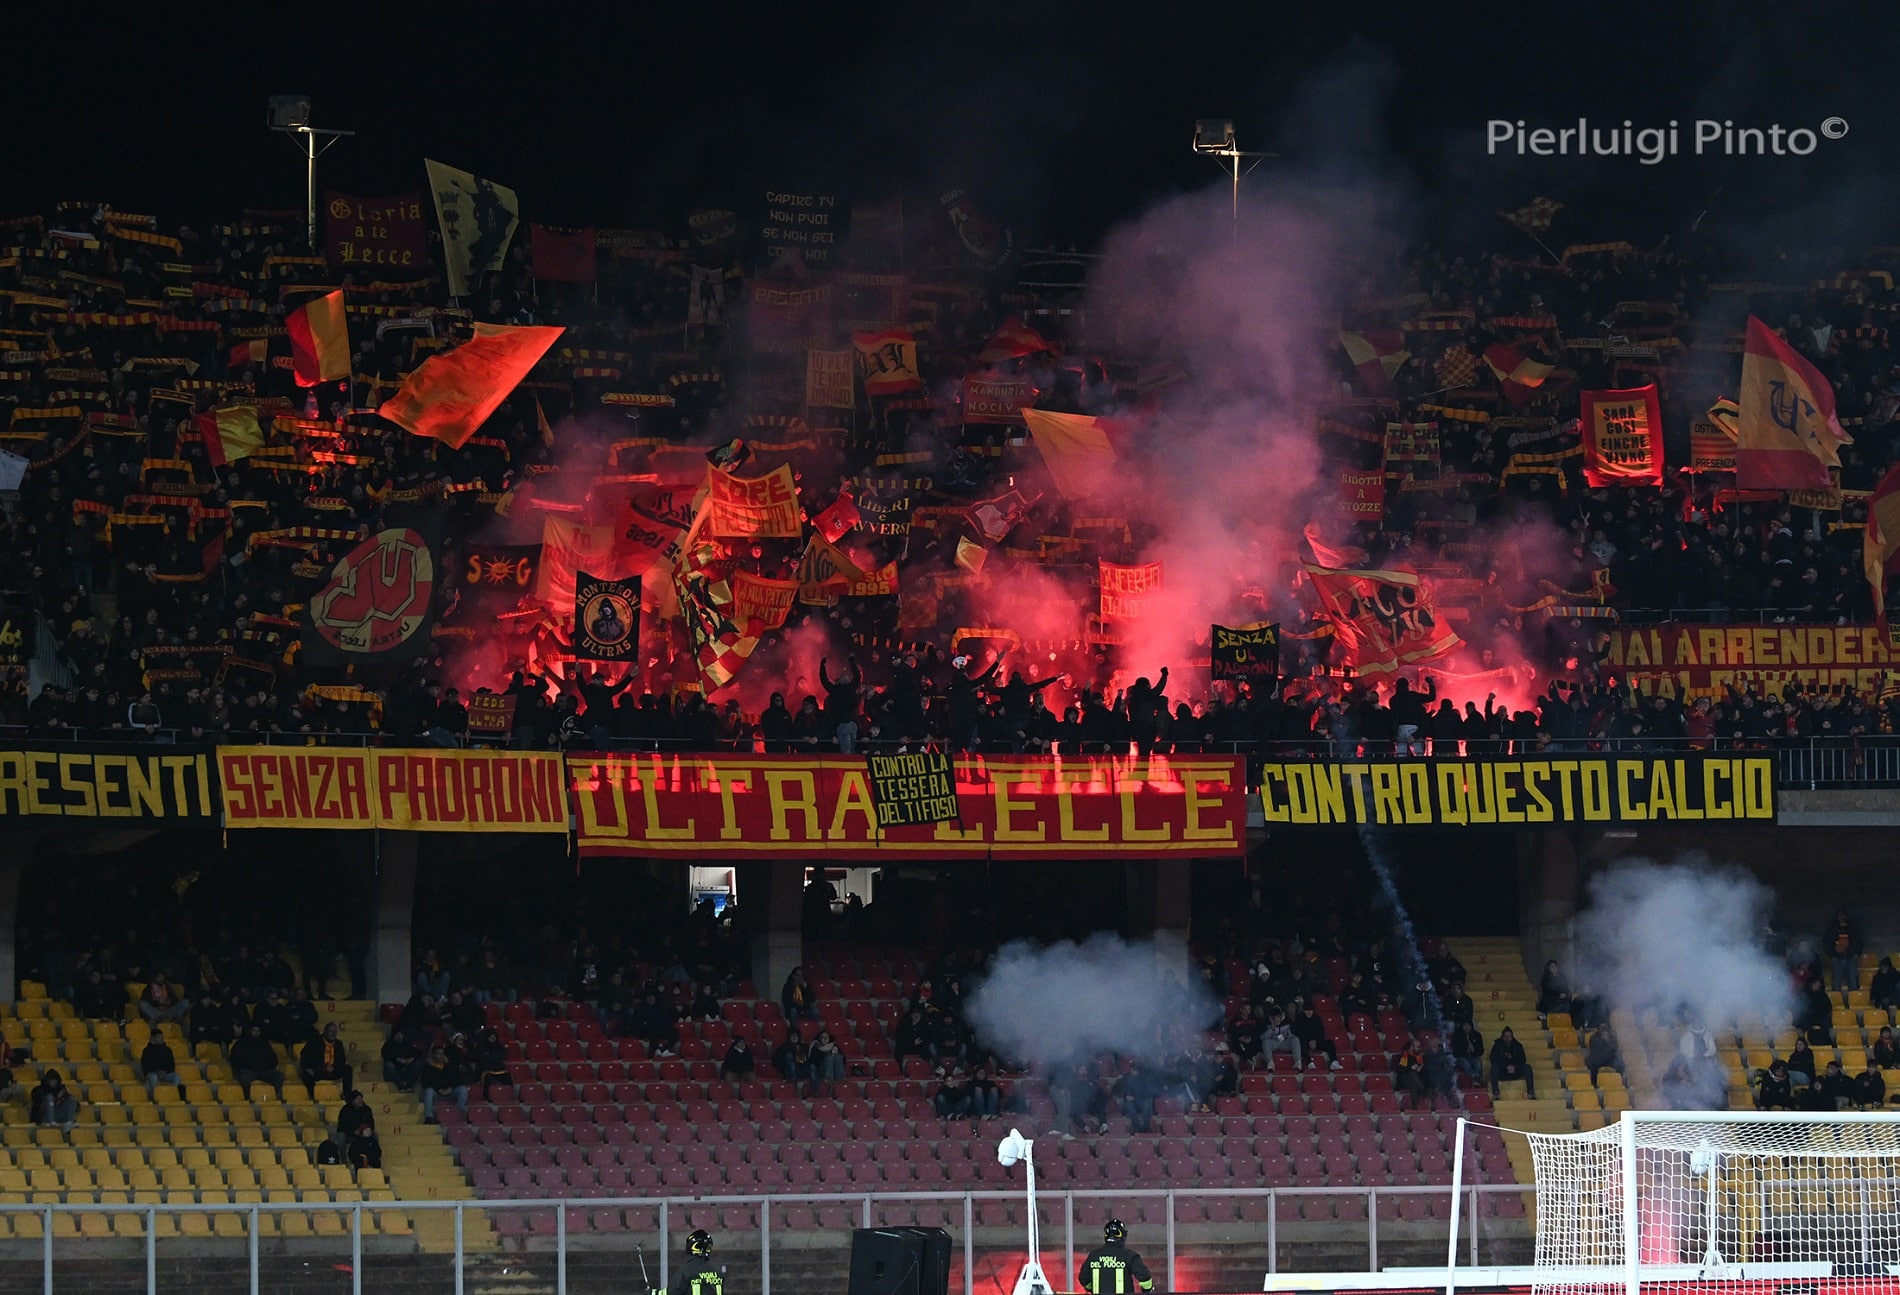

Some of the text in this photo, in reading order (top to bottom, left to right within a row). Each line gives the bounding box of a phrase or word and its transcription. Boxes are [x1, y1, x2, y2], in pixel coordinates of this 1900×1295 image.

[766, 191, 813, 207] CAPIRE
[330, 198, 422, 222] Gloria
[770, 210, 794, 224] NON
[762, 227, 834, 245] SE NON SEI
[337, 241, 413, 265] Lecce
[804, 249, 828, 261] NOI
[812, 353, 824, 369] IO
[969, 386, 1026, 397] MANDURIA
[1602, 405, 1636, 420] SARÀ
[1695, 457, 1737, 469] PRESENZA
[1341, 473, 1383, 486] RIDOTTI
[1357, 488, 1365, 499] A
[857, 495, 910, 514] LIBERI
[1340, 501, 1382, 513] STOZZE
[1100, 565, 1161, 593] INFERNO
[576, 581, 641, 609] MONTERONI
[848, 580, 891, 597] 1995
[581, 636, 632, 657] ULTRAS
[1217, 629, 1277, 649] SENZA
[1601, 629, 1664, 667] MAI
[1675, 626, 1900, 665] ARRENDER
[1214, 659, 1274, 676] PADRONI
[872, 753, 949, 778] CONTRO LA
[222, 755, 371, 819] SENZA
[378, 755, 564, 823] PADRONI
[876, 773, 951, 801] TESSERA
[1261, 758, 1773, 826] CONTRO QUESTO CALCIO
[572, 768, 885, 841] ULTRA
[878, 795, 958, 825] DEL TIFOSO
[1528, 1111, 1537, 1121] H
[393, 1125, 401, 1135] H
[1090, 1261, 1126, 1269] DEL FUOCO
